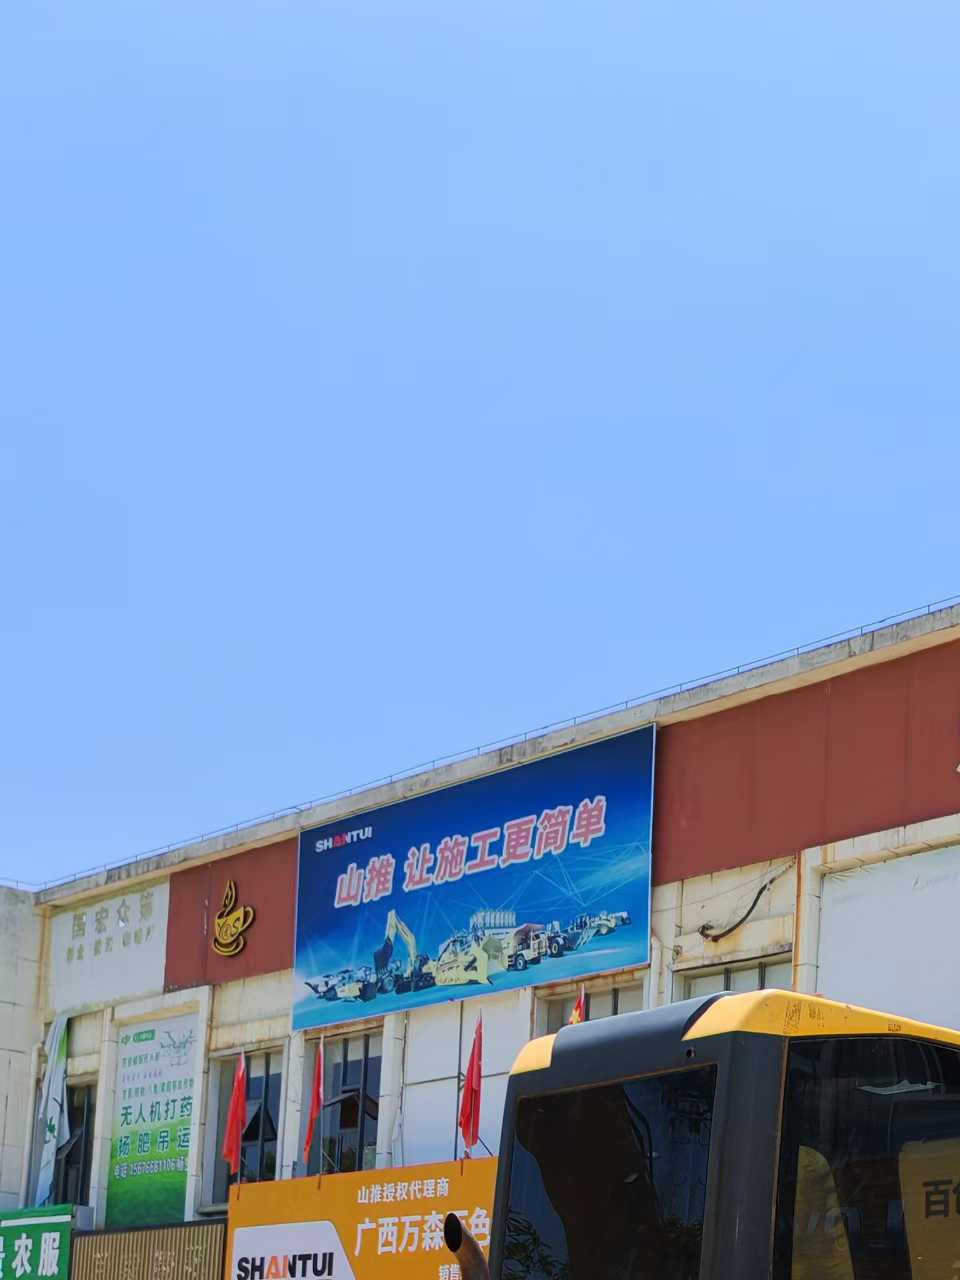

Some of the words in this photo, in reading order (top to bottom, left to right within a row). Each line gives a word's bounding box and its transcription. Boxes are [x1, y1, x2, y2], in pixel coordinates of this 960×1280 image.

[314, 826, 373, 853] SHANTUI
[334, 854, 396, 908] 山推
[402, 795, 607, 892] 让施工更简单
[120, 1095, 193, 1128] 无人机打药
[357, 1177, 449, 1204] 山推授权代理商
